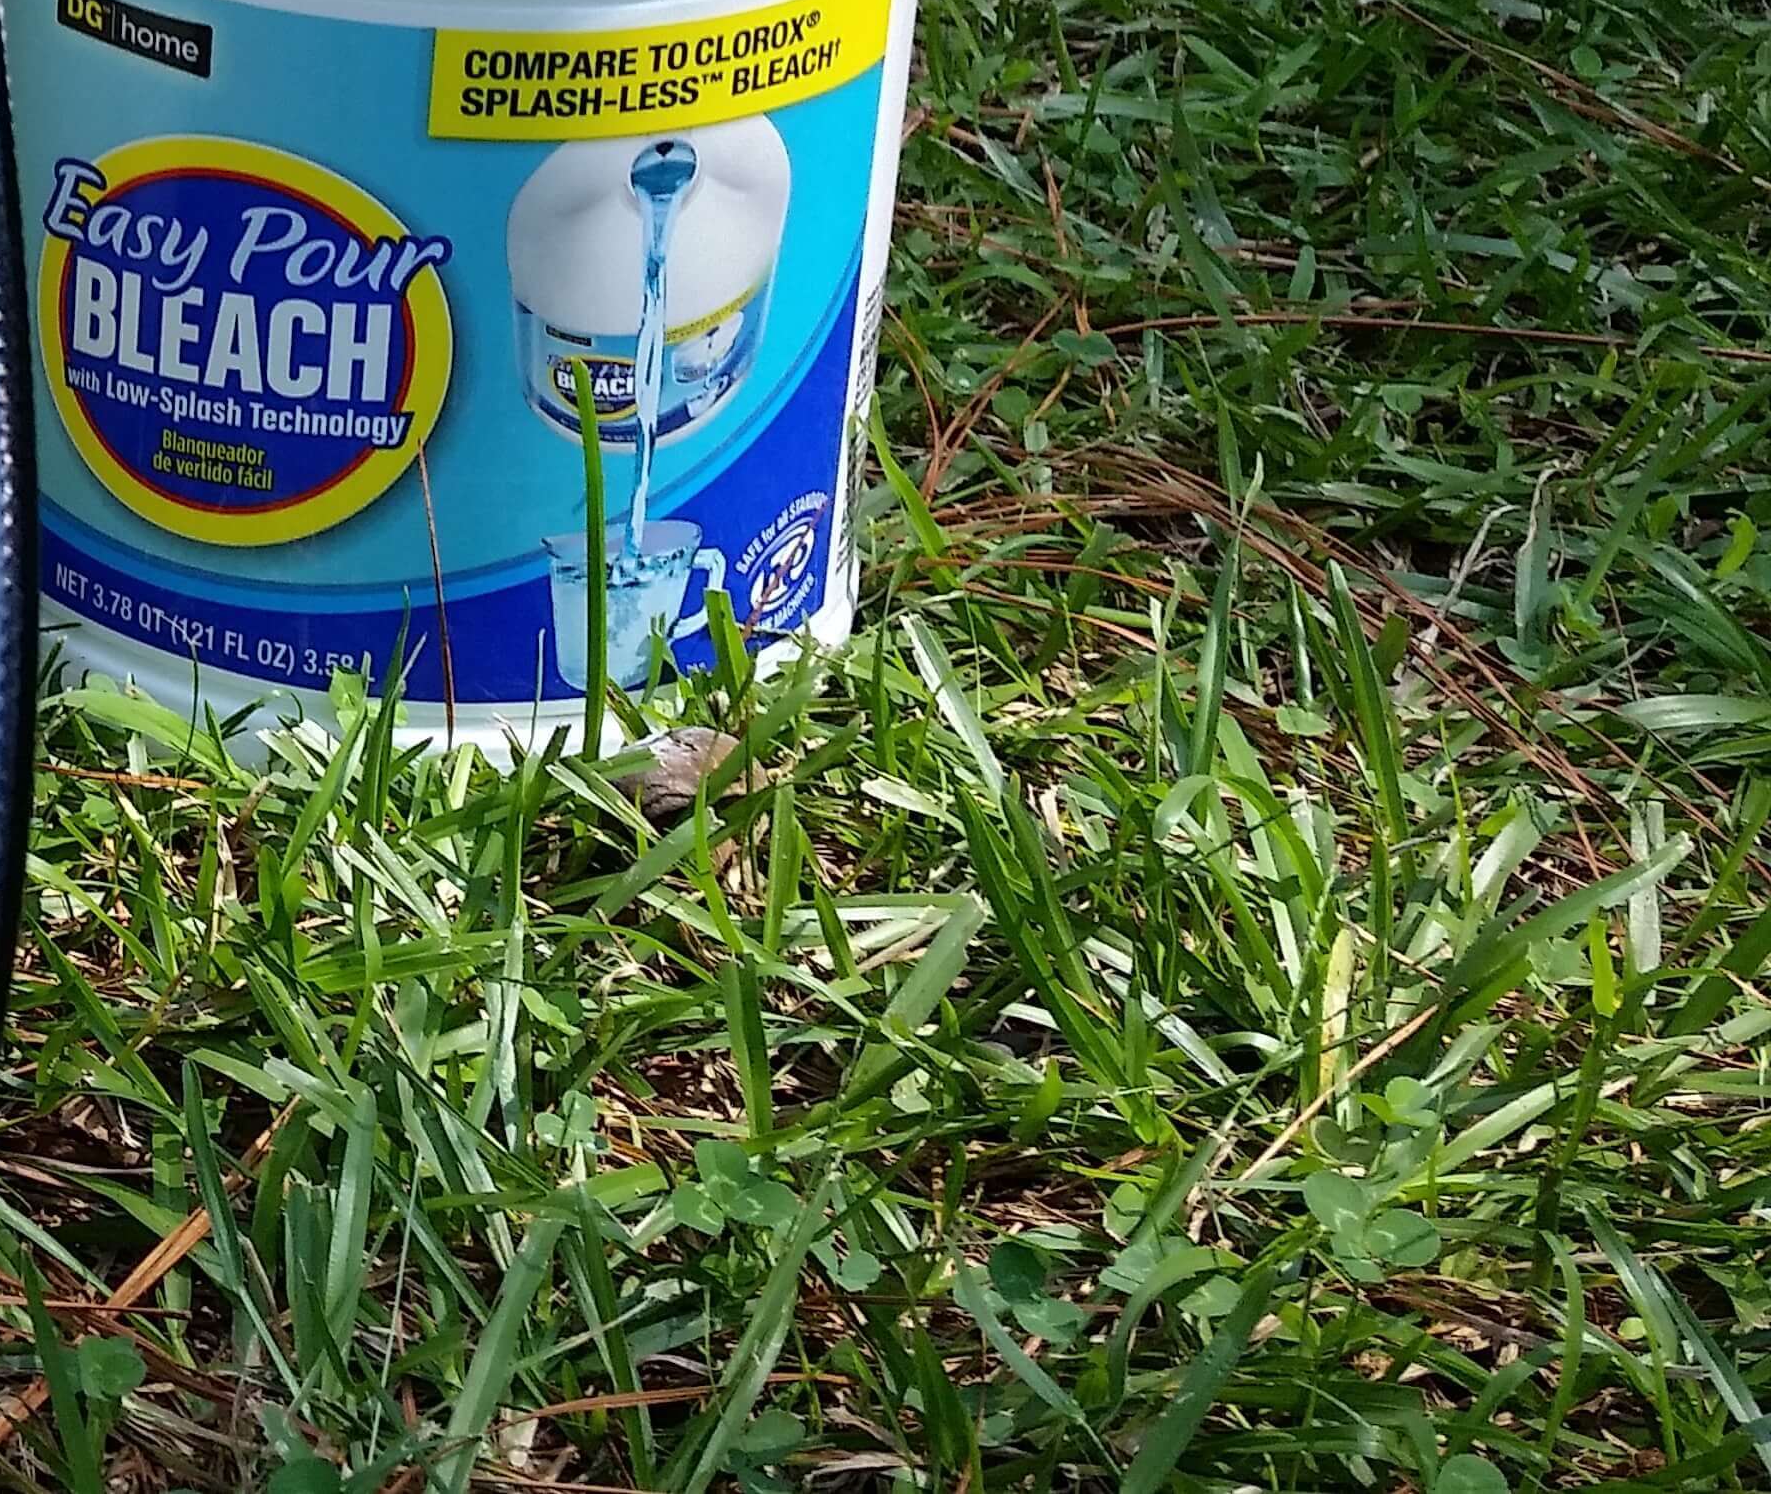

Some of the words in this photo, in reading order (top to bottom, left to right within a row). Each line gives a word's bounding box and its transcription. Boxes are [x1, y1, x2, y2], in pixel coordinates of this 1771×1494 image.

[121, 13, 200, 63] home
[463, 47, 639, 81] COMPARE
[649, 43, 688, 73] TO
[45, 162, 209, 292] Easy
[229, 205, 445, 292] Pour
[71, 256, 393, 404] BLEACH
[67, 366, 101, 394] with
[105, 372, 242, 428] Low-Splash
[249, 402, 407, 447] Technology
[152, 451, 173, 474] de
[176, 456, 234, 486] vertido
[237, 466, 274, 491] fácil
[162, 430, 266, 466] Blanqueador
[735, 537, 764, 576] SAFE
[761, 523, 777, 545] for
[56, 563, 89, 600] NET
[92, 584, 133, 621] 3.78
[138, 601, 165, 633] QT
[170, 615, 215, 651] (121
[224, 630, 250, 661] FL
[257, 638, 296, 677] OZ)
